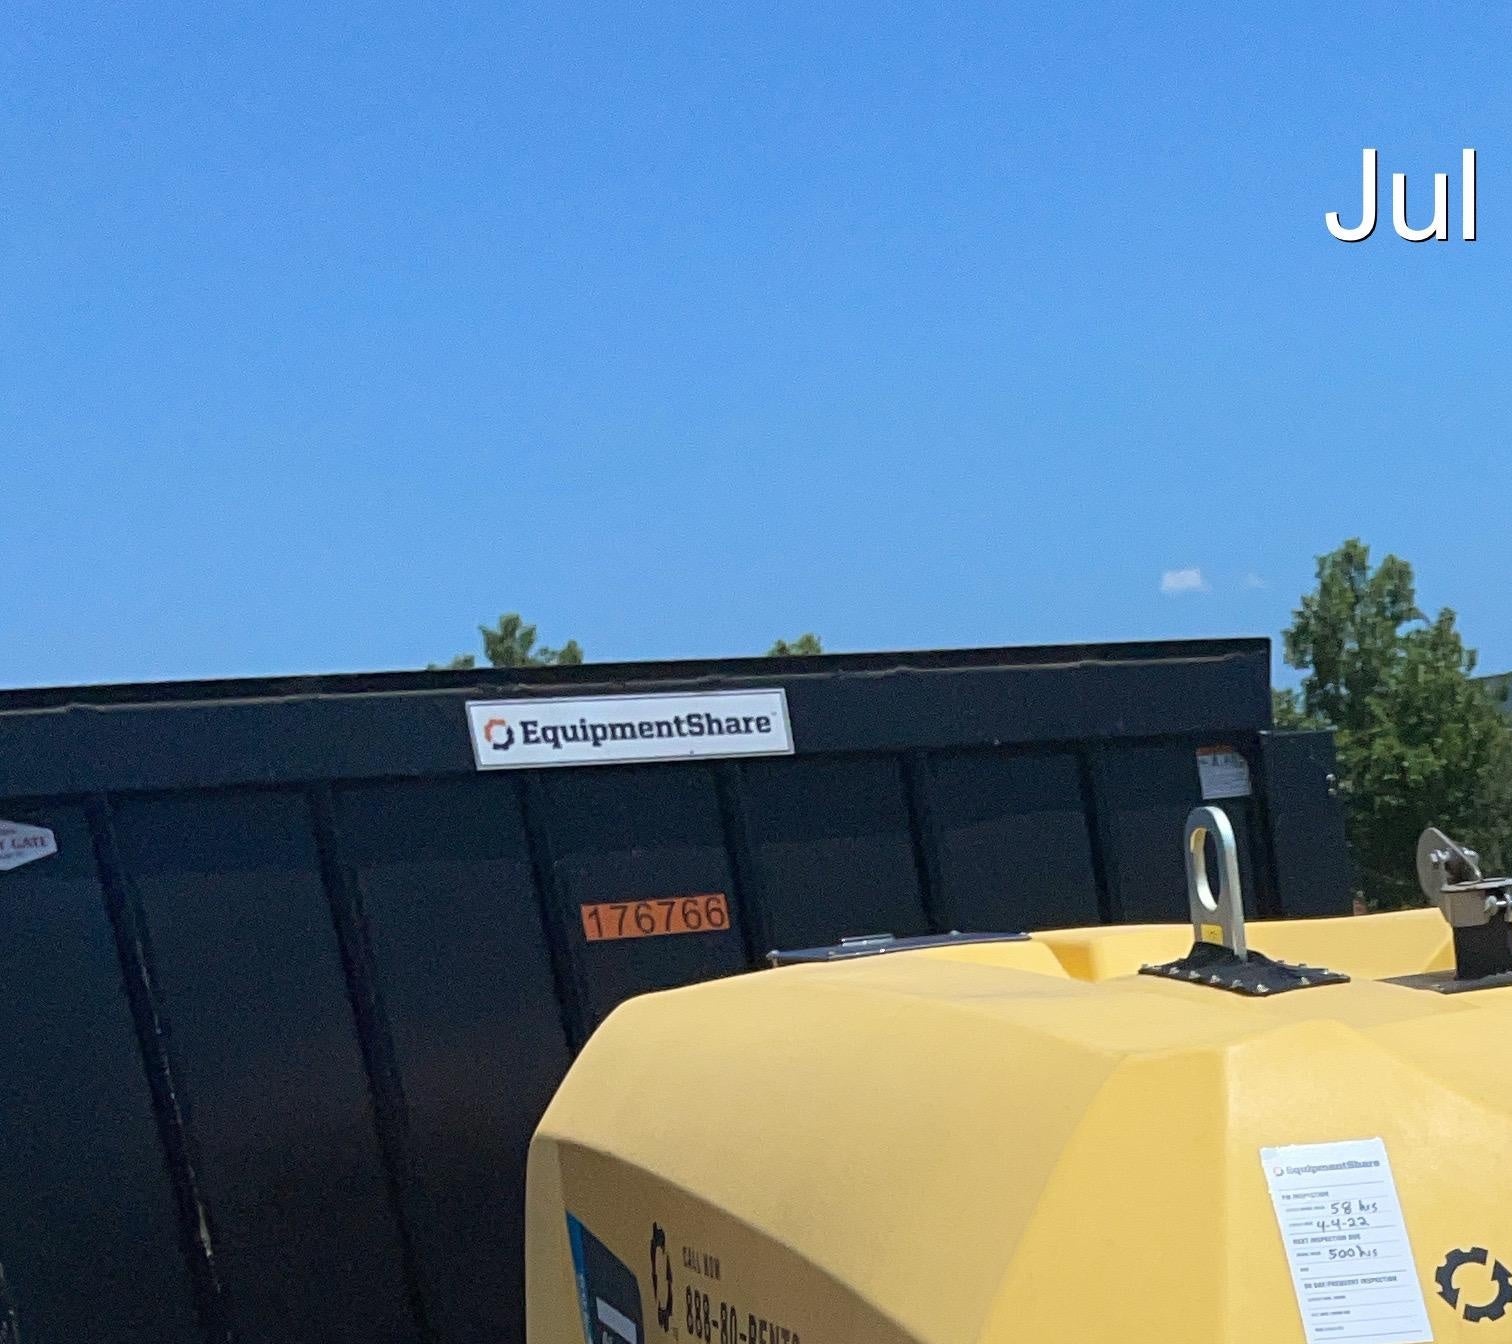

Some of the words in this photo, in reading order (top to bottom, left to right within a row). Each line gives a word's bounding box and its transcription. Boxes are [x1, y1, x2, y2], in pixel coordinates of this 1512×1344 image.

[519, 711, 772, 750] EquipmentShare
[588, 897, 726, 938] 176766
[1330, 1201, 1352, 1215] 58
[1316, 1216, 1370, 1233] 4-4-22
[1329, 1247, 1356, 1260] 500
